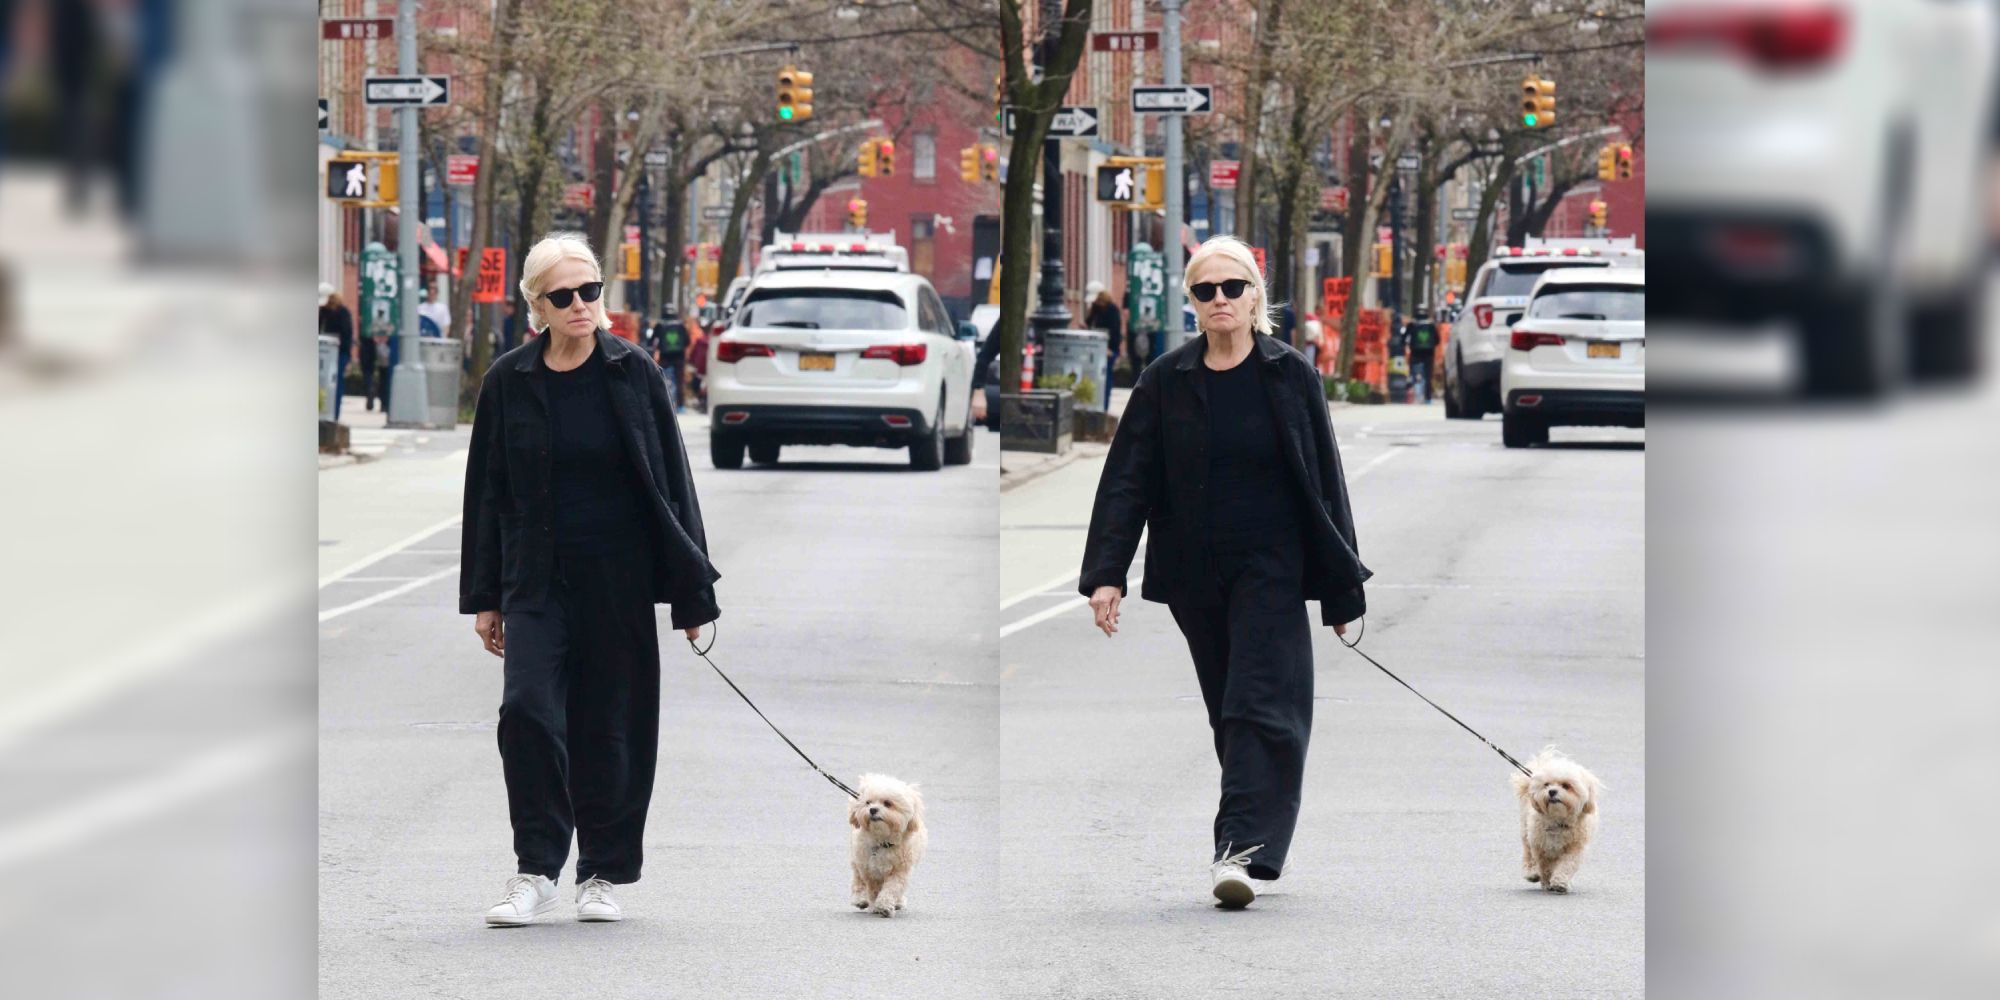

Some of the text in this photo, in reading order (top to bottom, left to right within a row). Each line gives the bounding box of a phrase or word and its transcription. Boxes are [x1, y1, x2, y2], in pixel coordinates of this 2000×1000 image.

[341, 23, 352, 38] W
[1109, 36, 1120, 50] W
[374, 85, 431, 98] ONE WAY
[1140, 95, 1195, 107] ONE WAY
[1056, 114, 1086, 127] WAY
